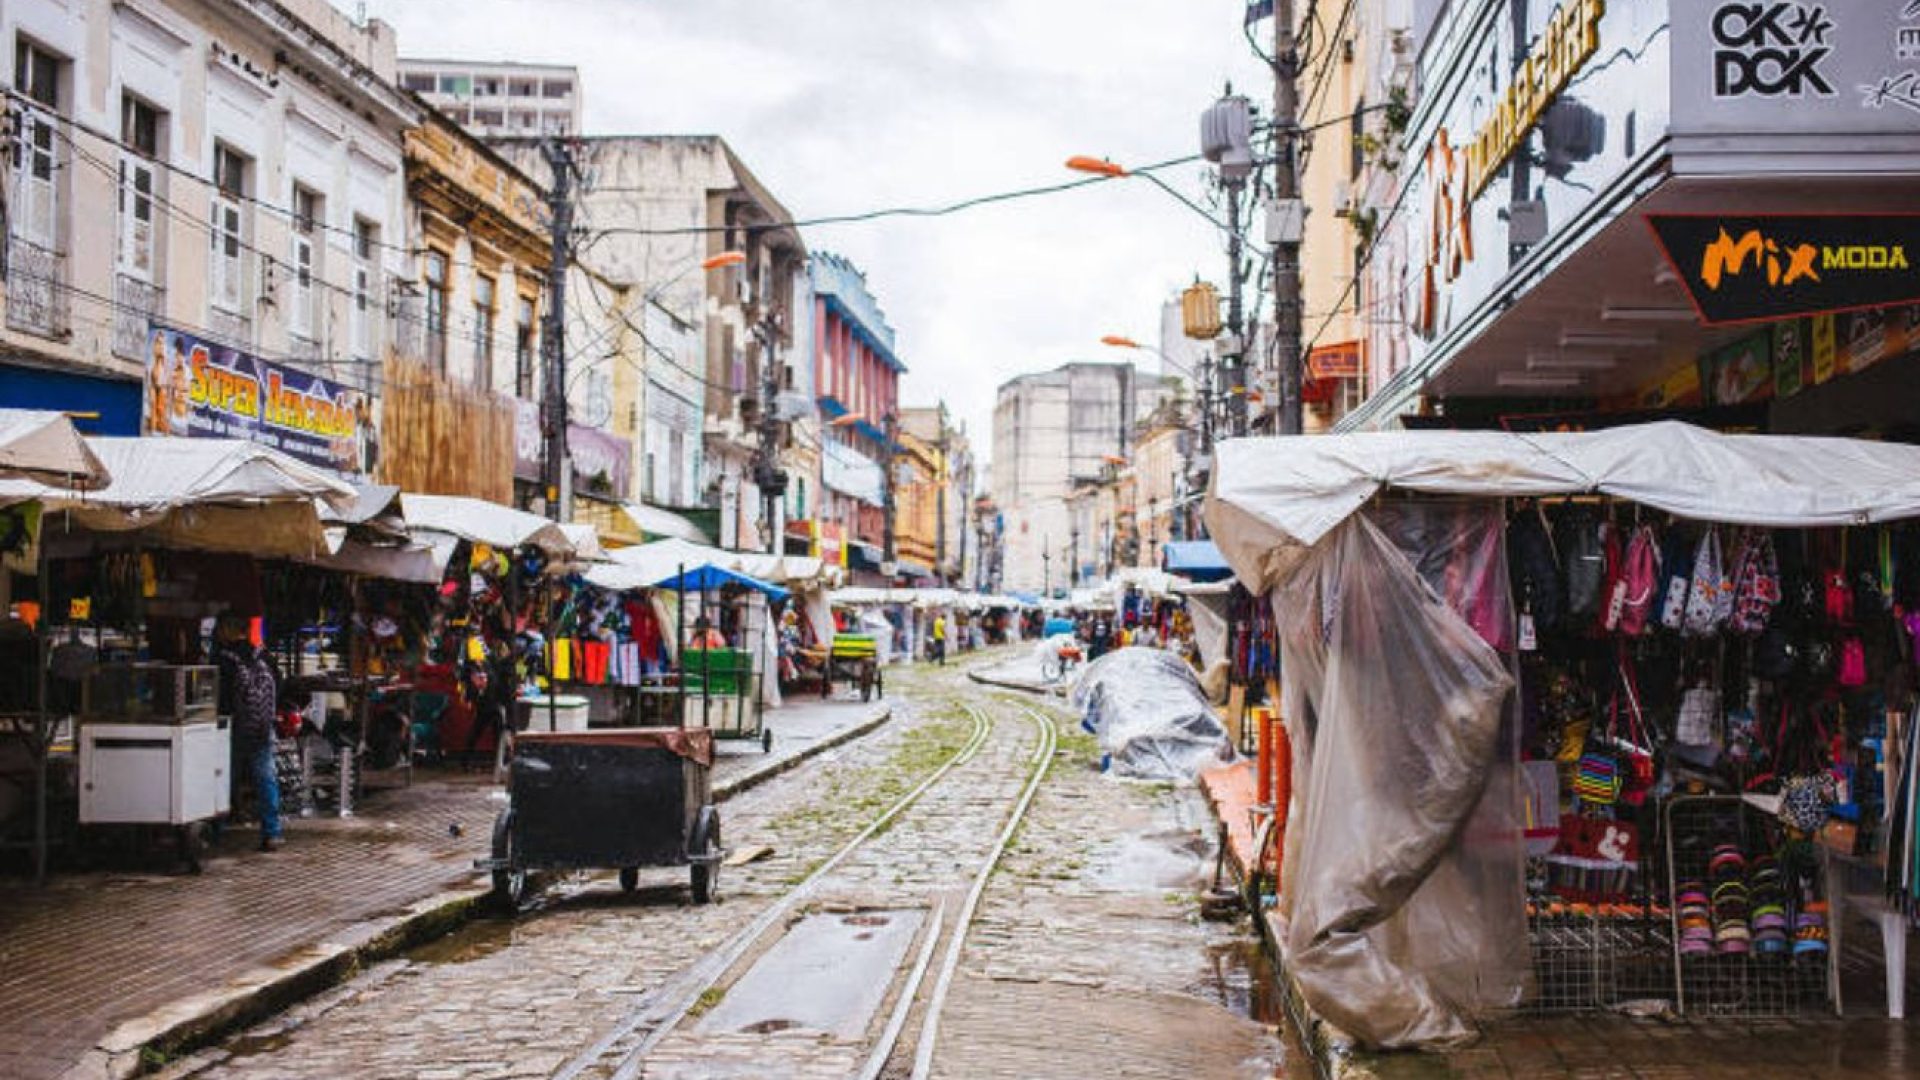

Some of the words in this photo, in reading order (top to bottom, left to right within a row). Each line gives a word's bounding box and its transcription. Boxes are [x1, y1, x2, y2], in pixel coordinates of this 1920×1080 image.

[1714, 48, 1835, 96] DOK
[1700, 224, 1821, 290] Mix
[1822, 246, 1909, 270] MODA
